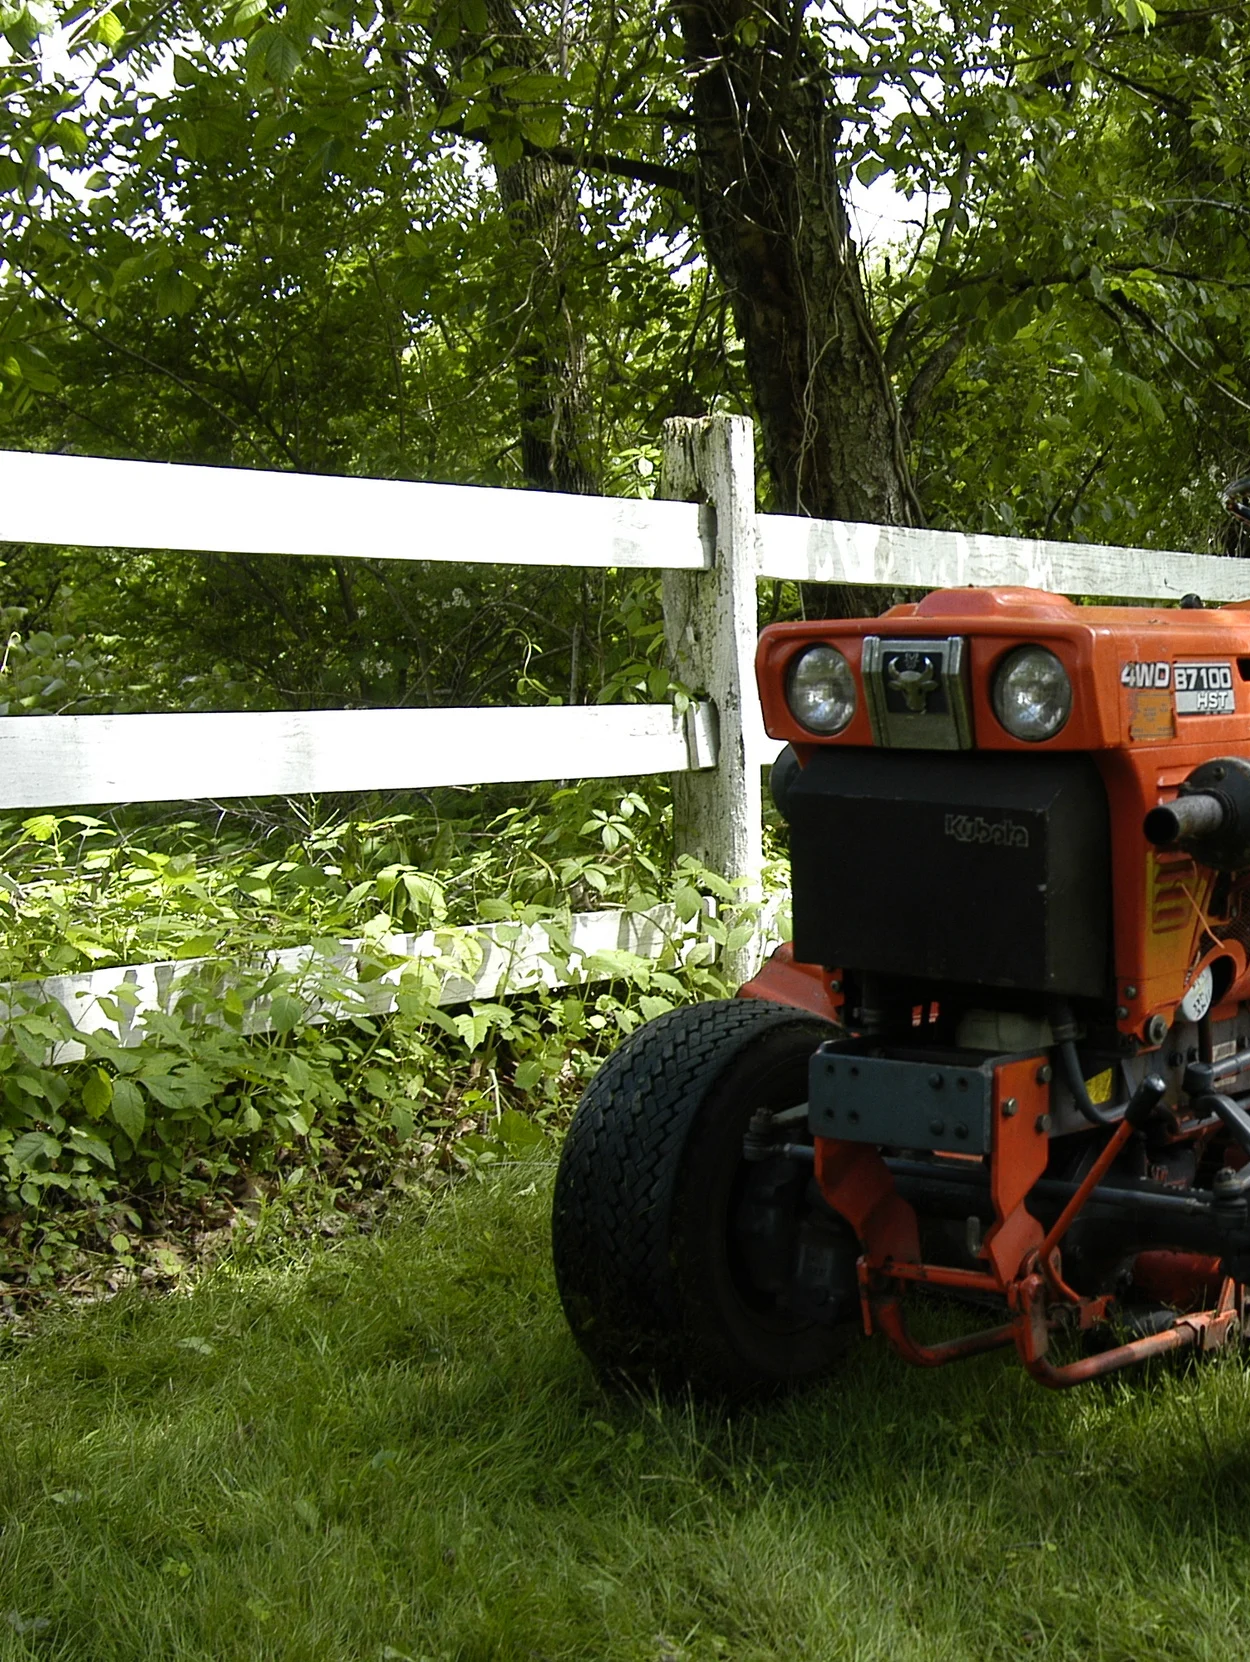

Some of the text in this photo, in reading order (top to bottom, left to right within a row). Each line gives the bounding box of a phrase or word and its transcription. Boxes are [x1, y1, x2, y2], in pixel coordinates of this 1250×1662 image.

[1120, 661, 1170, 688] 4WD
[1174, 668, 1232, 690] B7100
[1197, 691, 1229, 709] HST
